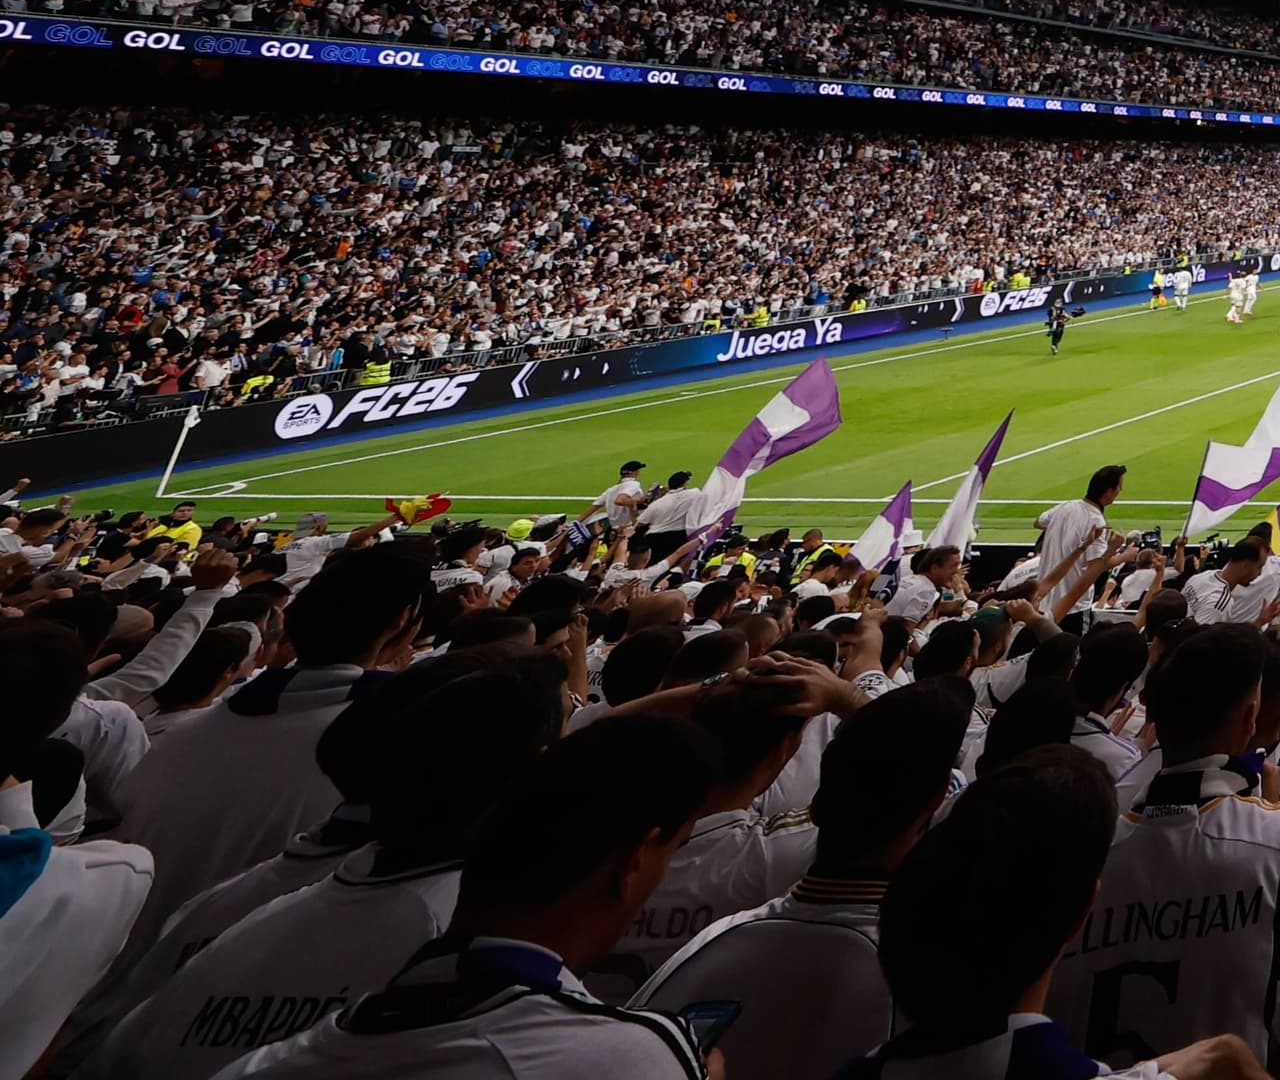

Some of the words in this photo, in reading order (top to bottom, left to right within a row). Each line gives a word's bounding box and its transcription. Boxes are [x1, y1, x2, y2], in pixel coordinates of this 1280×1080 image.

[0, 20, 32, 40] OL
[45, 24, 113, 47] GOL
[124, 31, 185, 51] GOL
[194, 35, 252, 56] GOL
[261, 41, 314, 59] GOL
[320, 44, 371, 64] GOL
[379, 50, 424, 67] GOL
[429, 52, 474, 71] GOL
[480, 58, 520, 74] GOL
[570, 65, 605, 80] GOL
[648, 71, 679, 85] GOL
[719, 78, 747, 91] GOL
[820, 84, 844, 96] GOL
[874, 88, 896, 99] GOL
[922, 92, 943, 102] GOL
[967, 94, 986, 105] GOL
[1008, 97, 1026, 108] GOL
[1046, 100, 1062, 110] GOL
[1081, 102, 1097, 113] GOL
[1192, 264, 1206, 283] Ya
[997, 286, 1053, 313] FC26
[716, 328, 807, 362] Juega
[814, 315, 844, 345] Ya
[288, 403, 321, 422] EA
[326, 373, 481, 430] FC26
[282, 416, 321, 430] SPORTS
[625, 904, 714, 939] ALDO
[1063, 884, 1265, 958] LLINGHAM
